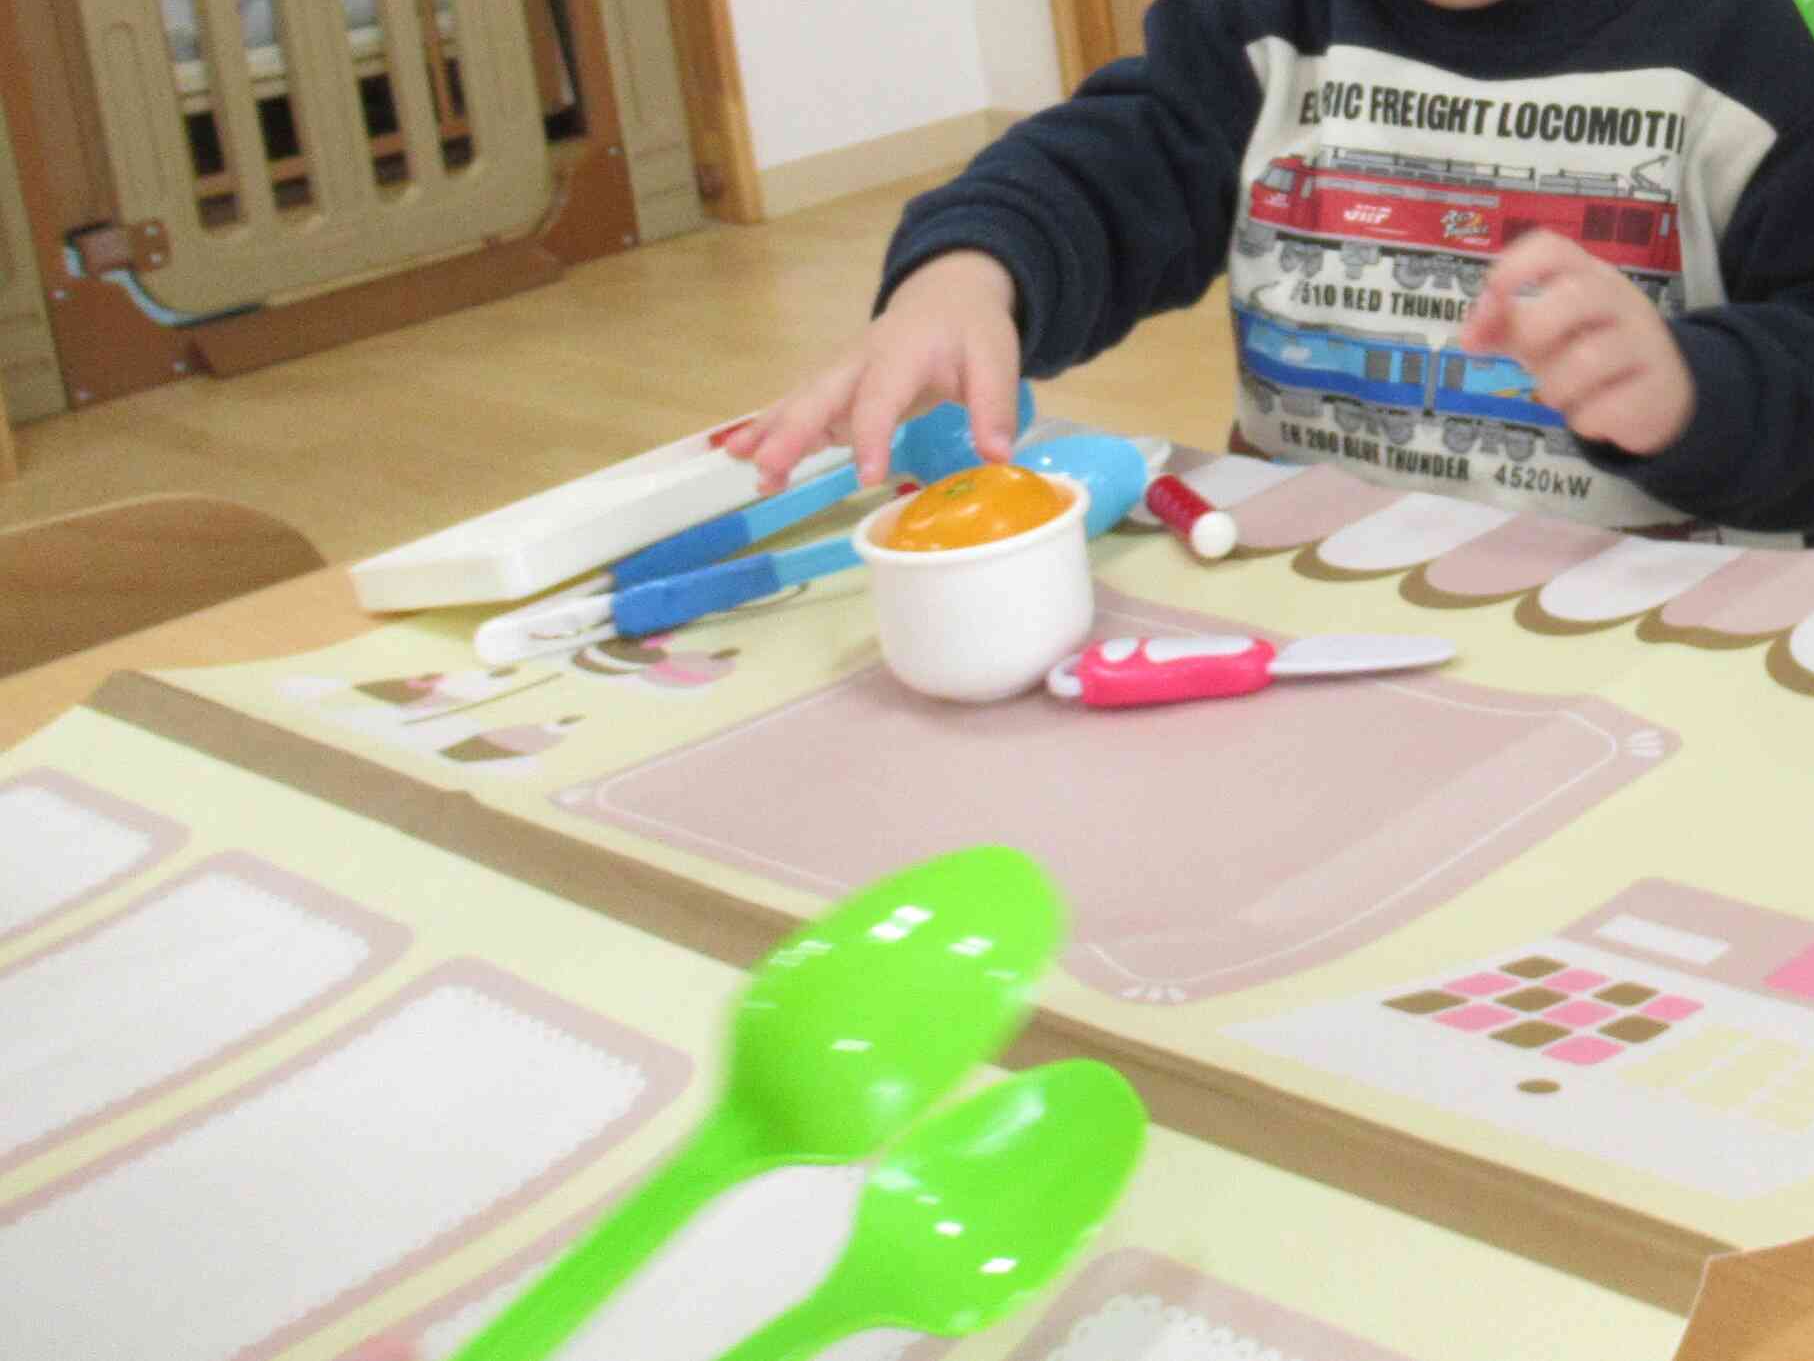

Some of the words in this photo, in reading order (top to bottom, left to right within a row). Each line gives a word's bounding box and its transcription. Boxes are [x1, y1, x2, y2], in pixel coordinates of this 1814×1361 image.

[1369, 85, 1495, 136] FREIGHT
[1342, 285, 1383, 312] RED
[1390, 290, 1467, 323] THUNDE
[1386, 445, 1471, 481] THUNDER
[1493, 462, 1593, 499] 4520kW
